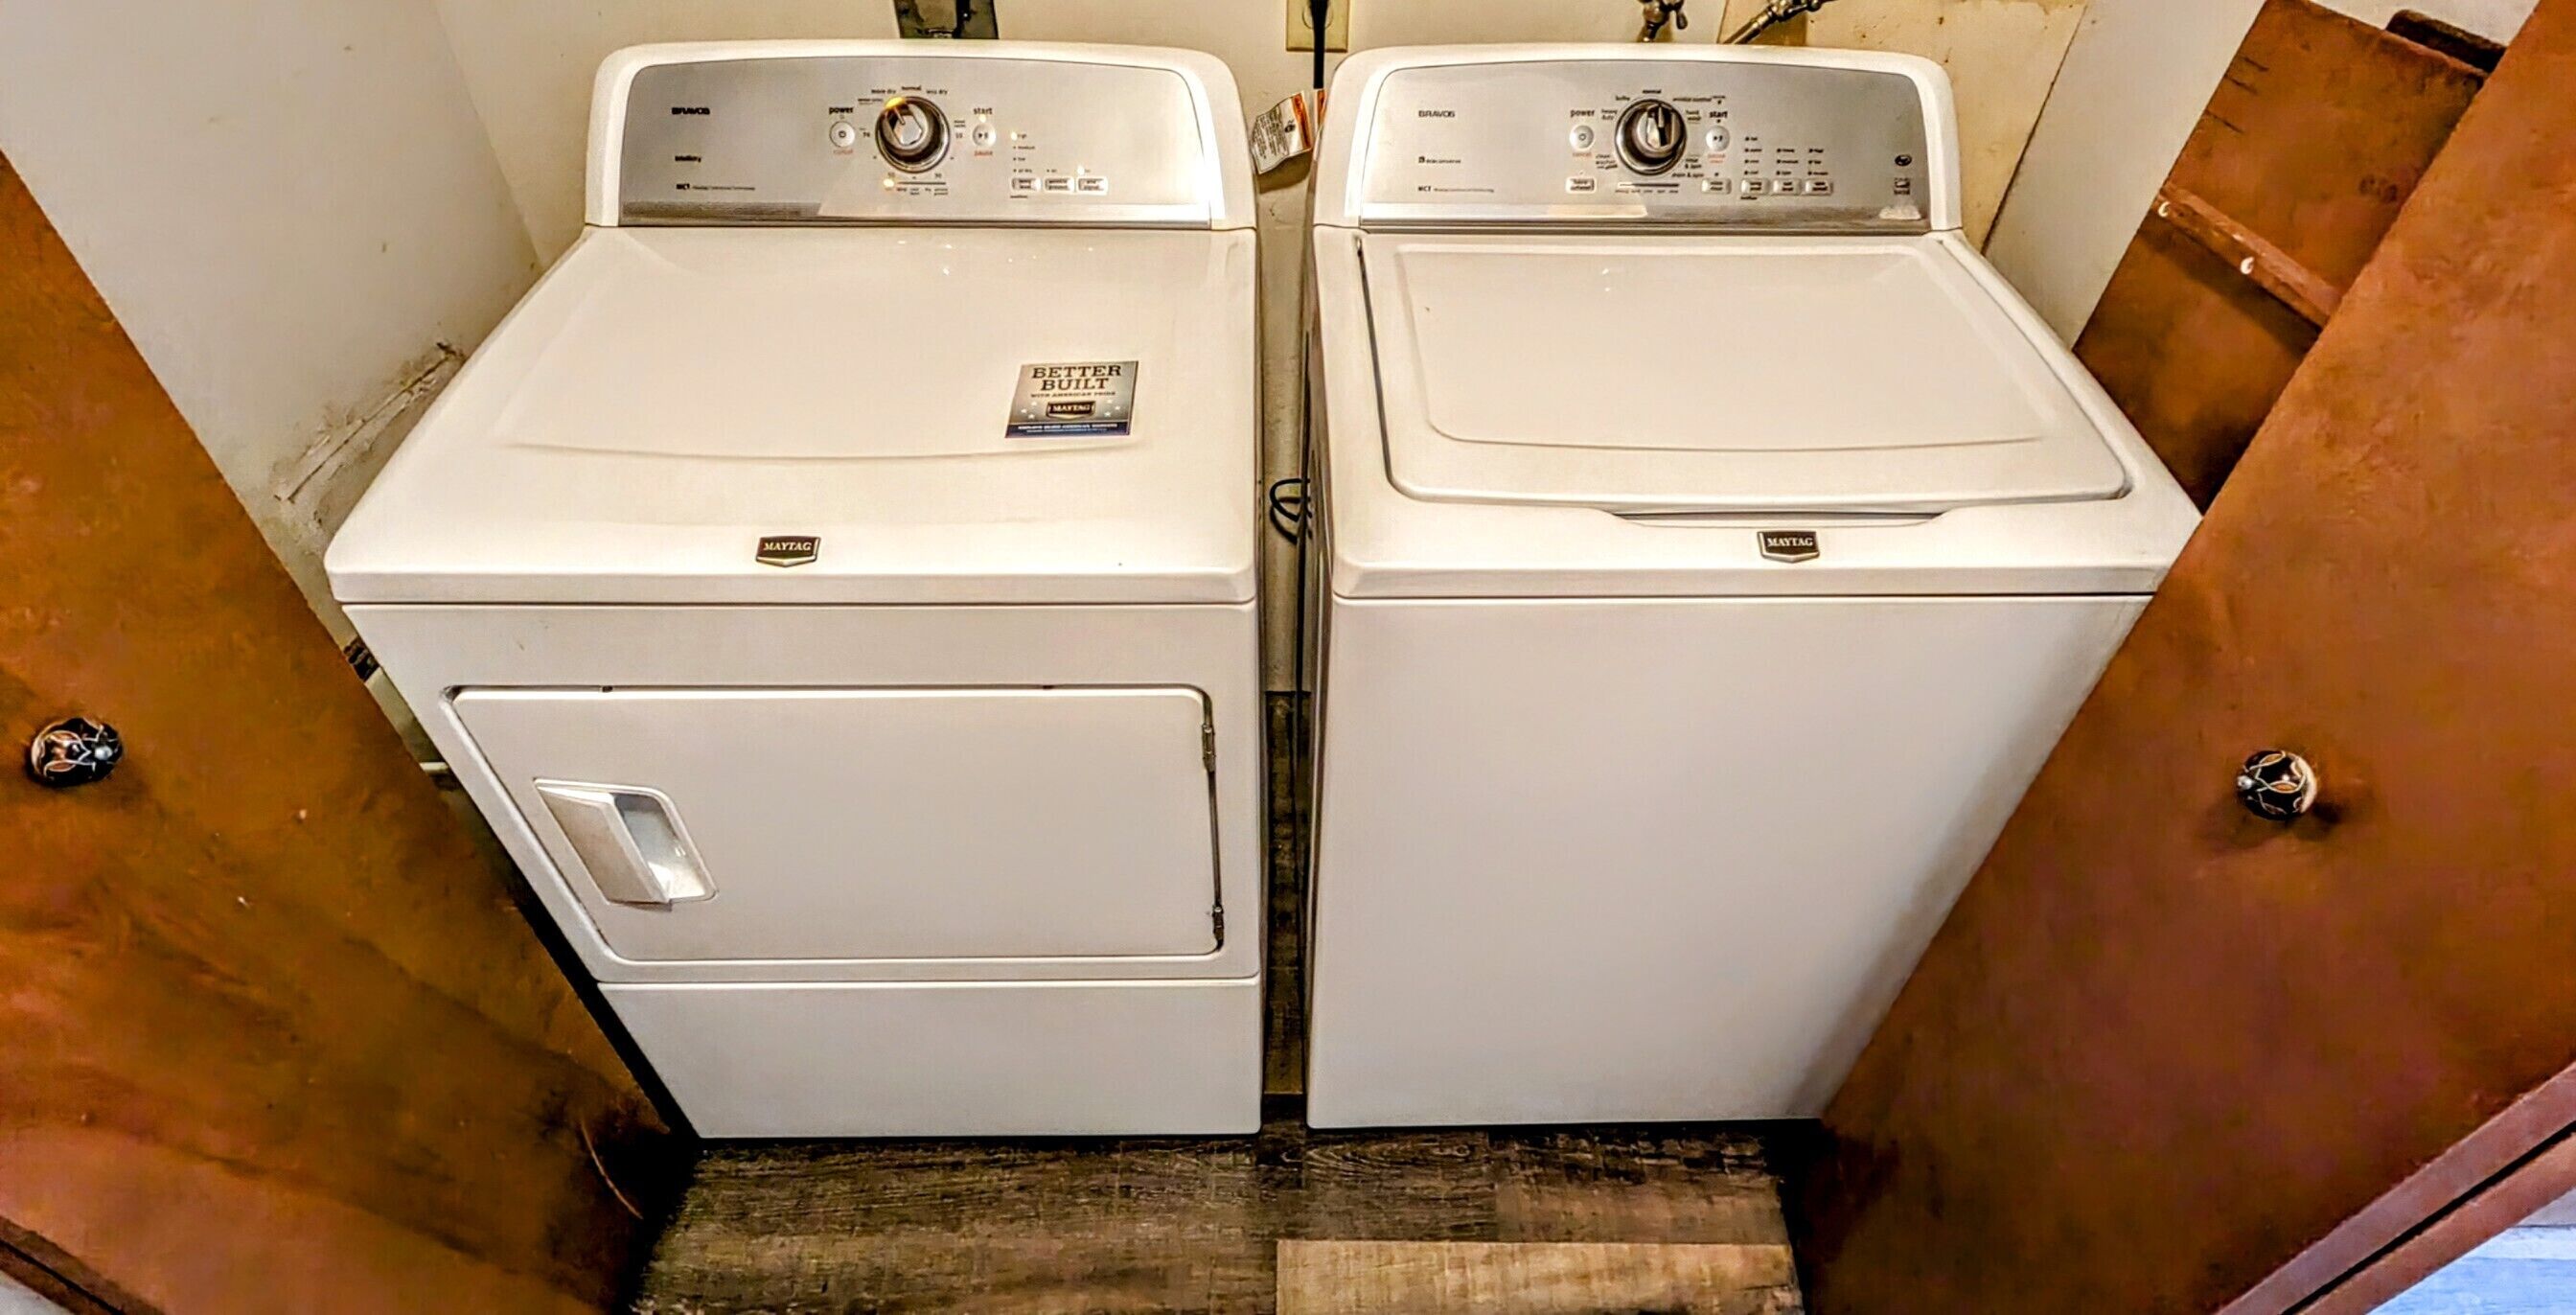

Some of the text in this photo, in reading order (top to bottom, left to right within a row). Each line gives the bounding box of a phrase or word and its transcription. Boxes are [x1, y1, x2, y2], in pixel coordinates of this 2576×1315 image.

[829, 106, 854, 115] power
[1570, 109, 1595, 118] power
[1032, 365, 1121, 379] BETTER
[1041, 378, 1109, 391] BUILT
[763, 542, 813, 551] MAYTAG
[1767, 537, 1814, 547] MAYTAG
